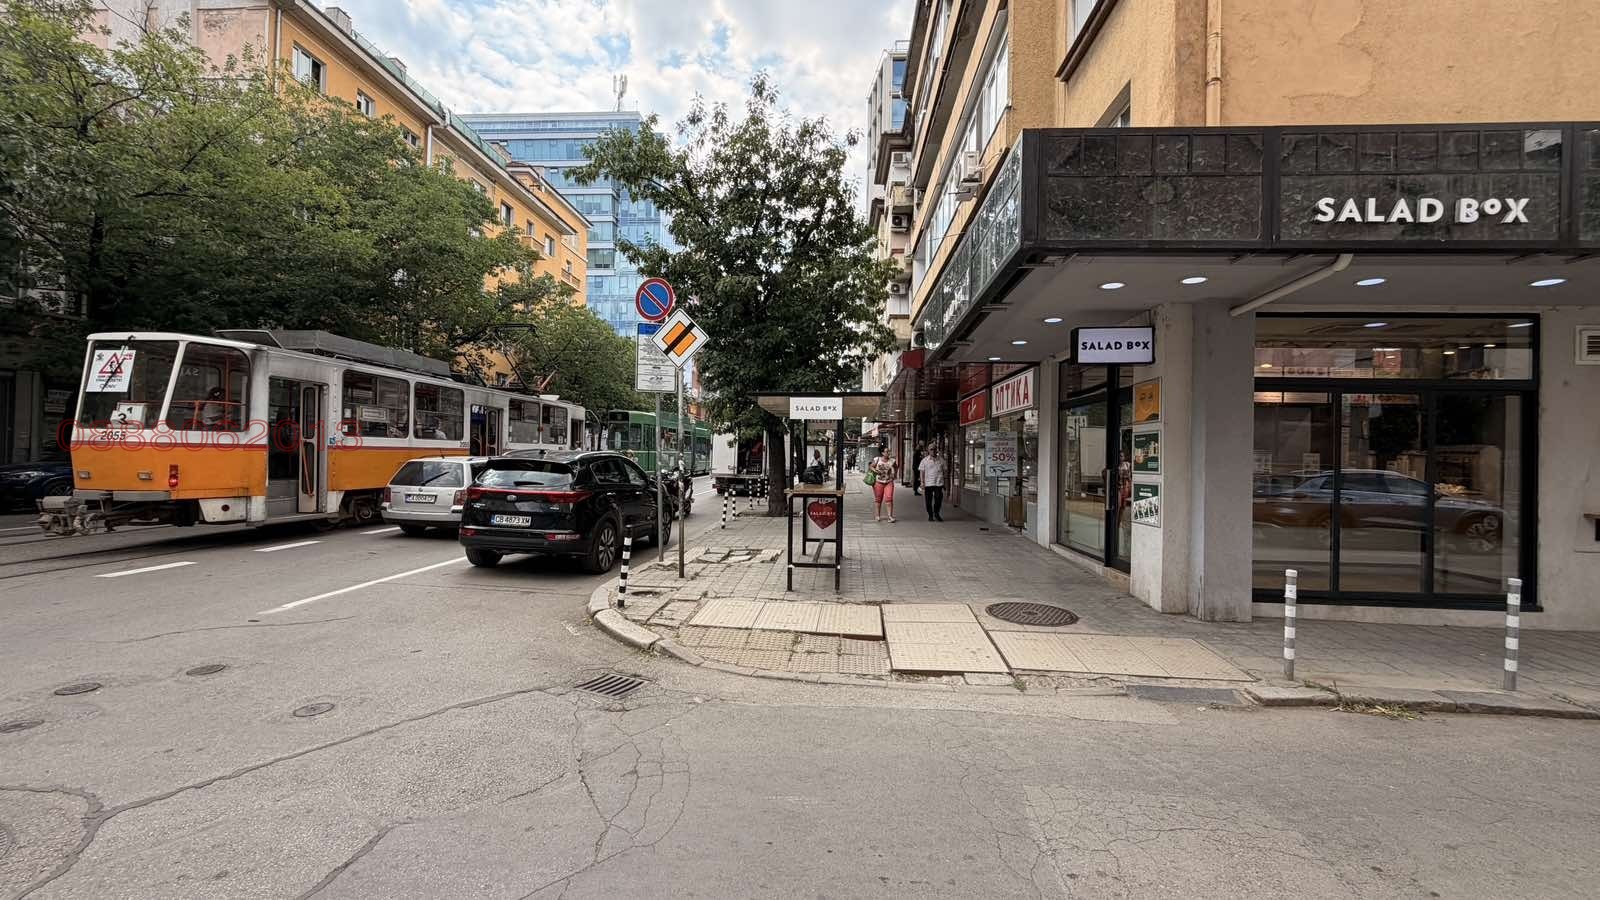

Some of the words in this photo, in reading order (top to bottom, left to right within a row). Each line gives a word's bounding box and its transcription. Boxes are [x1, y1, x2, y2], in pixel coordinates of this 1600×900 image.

[1315, 197, 1445, 223] SALAD
[1081, 341, 1122, 350] SALAD
[995, 375, 1029, 412] ОПТИКА
[100, 431, 126, 440] 2055
[987, 452, 1016, 462] -50%
